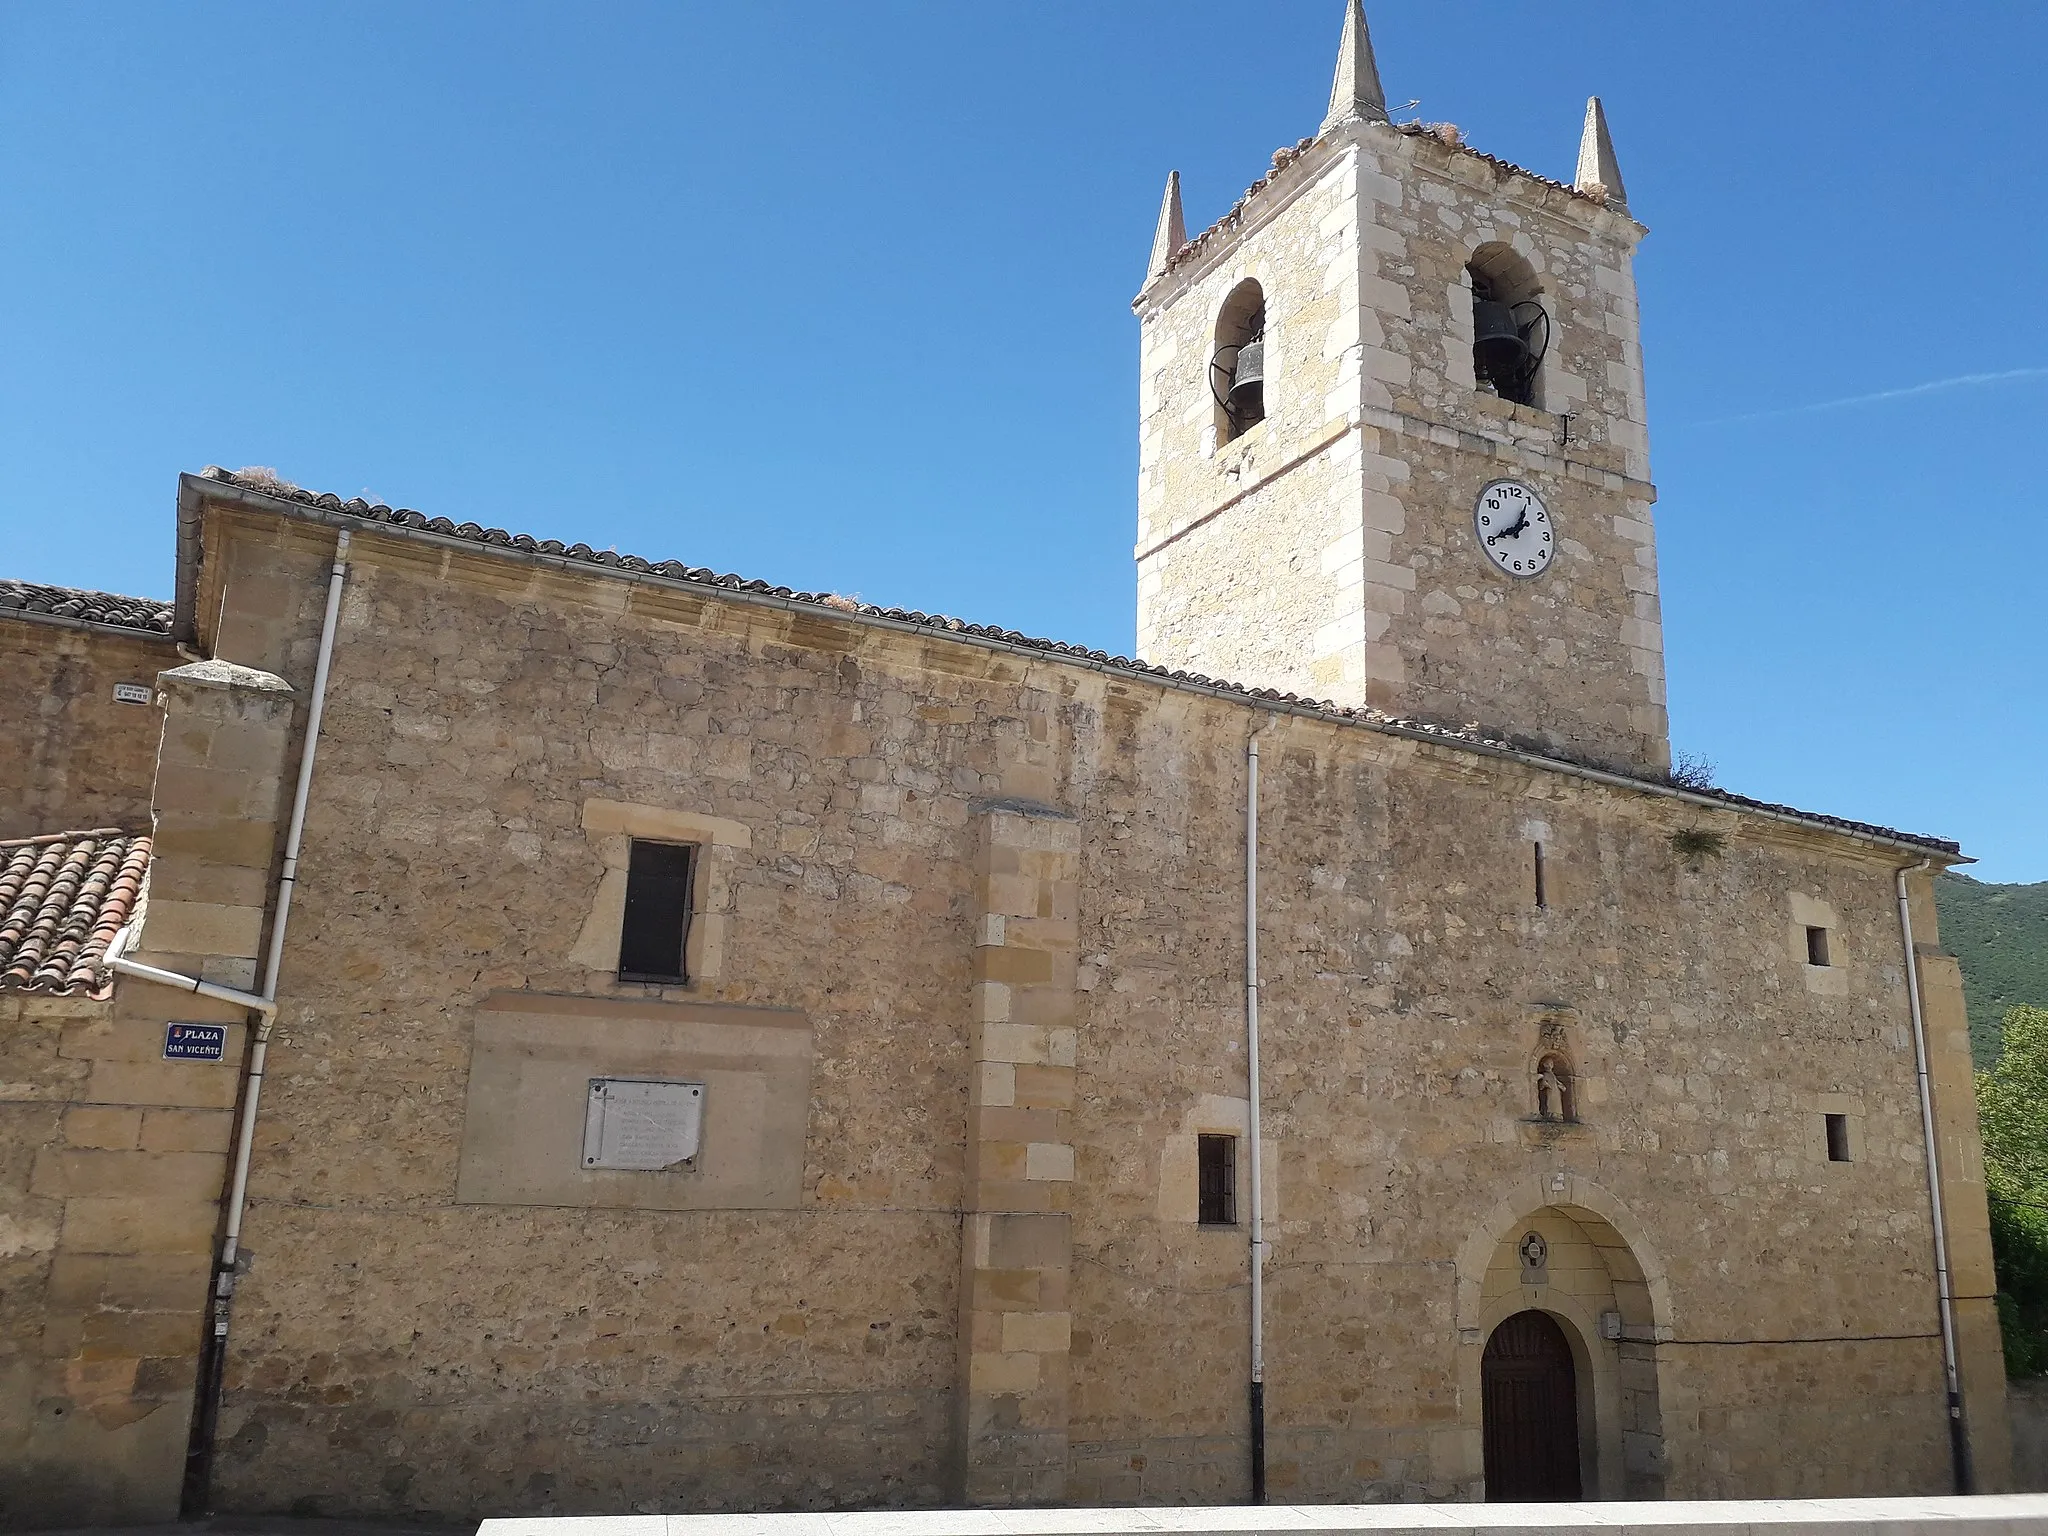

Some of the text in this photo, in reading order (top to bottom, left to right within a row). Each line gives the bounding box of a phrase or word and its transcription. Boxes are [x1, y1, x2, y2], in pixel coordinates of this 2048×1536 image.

[1496, 488, 1507, 499] 11
[1508, 487, 1522, 498] 12
[1486, 499, 1500, 510] 10
[1526, 496, 1531, 505] 1
[1481, 516, 1490, 526] 9
[1537, 512, 1545, 522] 2
[1487, 536, 1496, 546] 8
[1542, 532, 1550, 541] 3
[1499, 552, 1508, 562] 7
[1538, 549, 1546, 559] 4
[1513, 561, 1522, 571] 6
[1528, 560, 1536, 570] 5
[185, 1030, 218, 1040] PLAZA
[168, 1045, 220, 1054] SAN VICENTE
